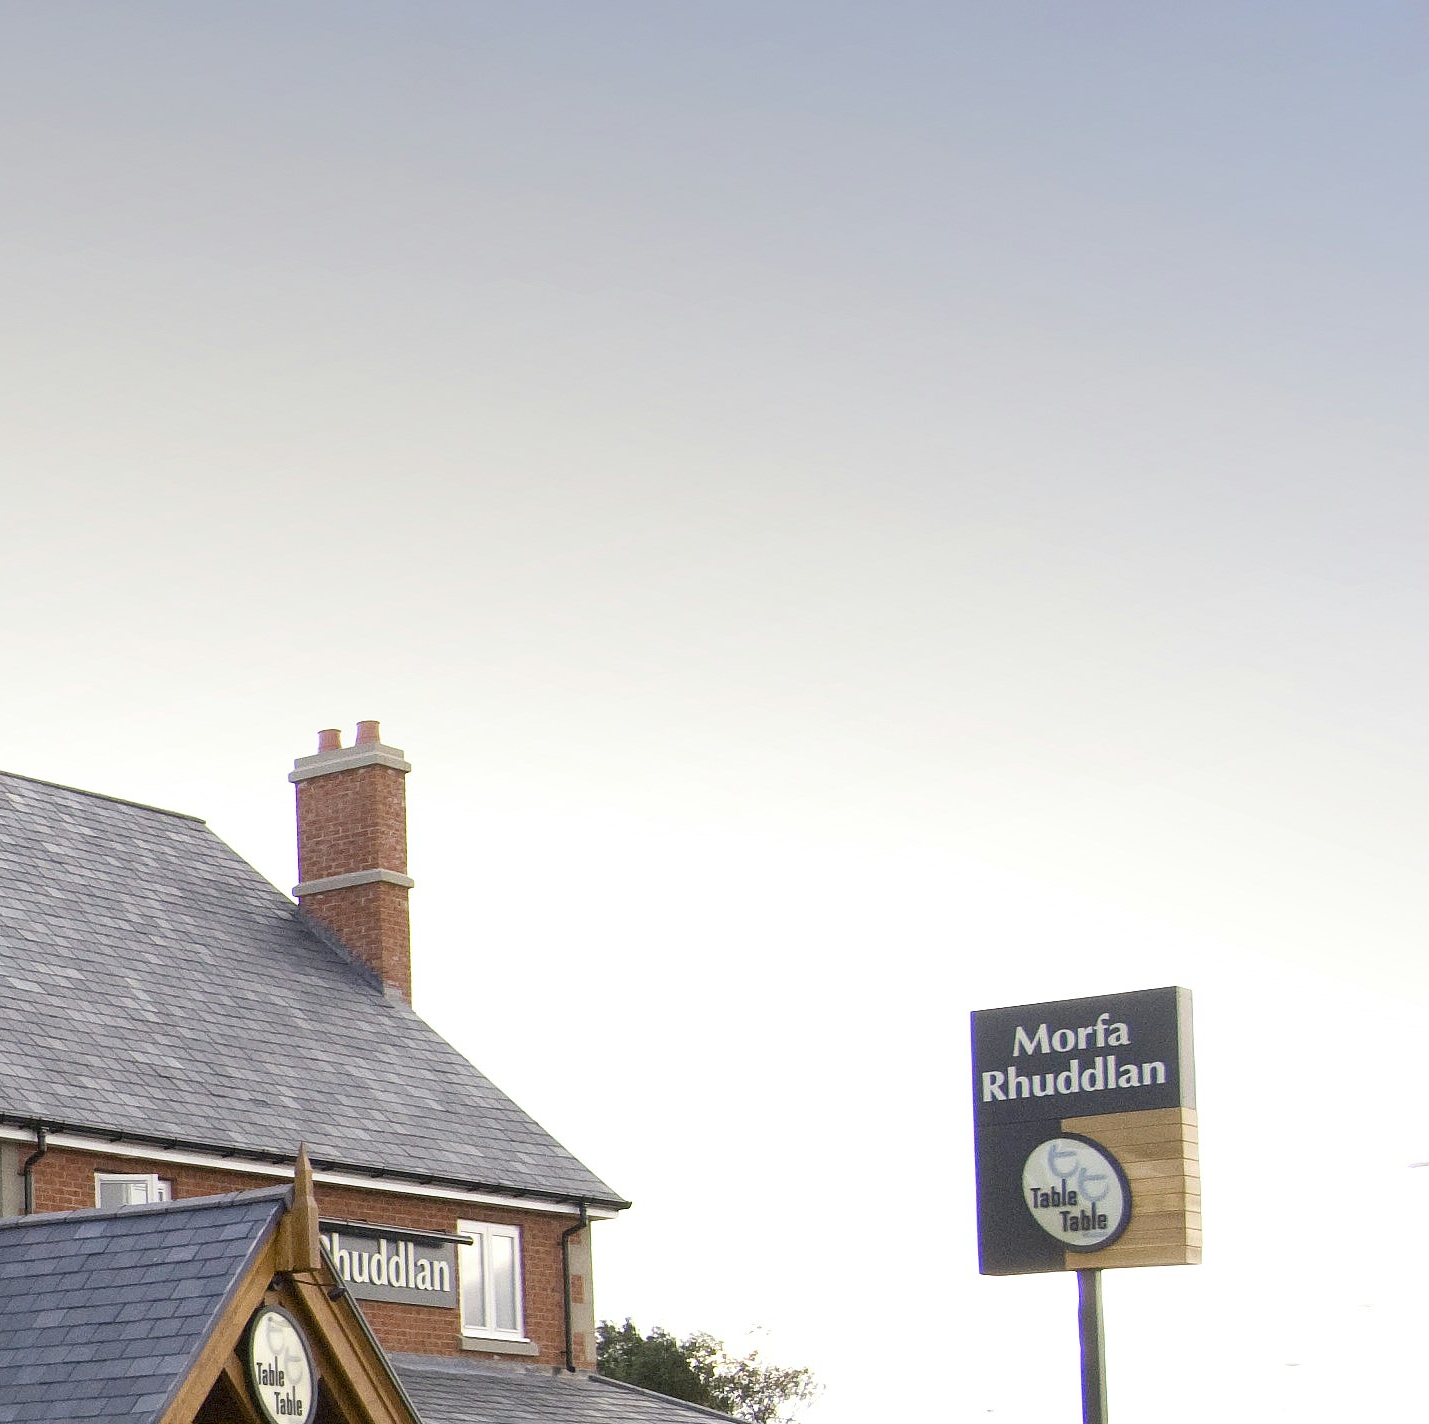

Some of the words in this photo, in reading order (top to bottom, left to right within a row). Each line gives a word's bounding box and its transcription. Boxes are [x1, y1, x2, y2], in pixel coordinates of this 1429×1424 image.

[1012, 1012, 1131, 1057] Morfa
[981, 1055, 1167, 1102] Rhuddlan
[1030, 1179, 1078, 1209] Table
[1060, 1202, 1108, 1233] Table
[321, 1232, 451, 1292] huddlan
[256, 1356, 285, 1387] Table
[274, 1386, 303, 1417] Table
